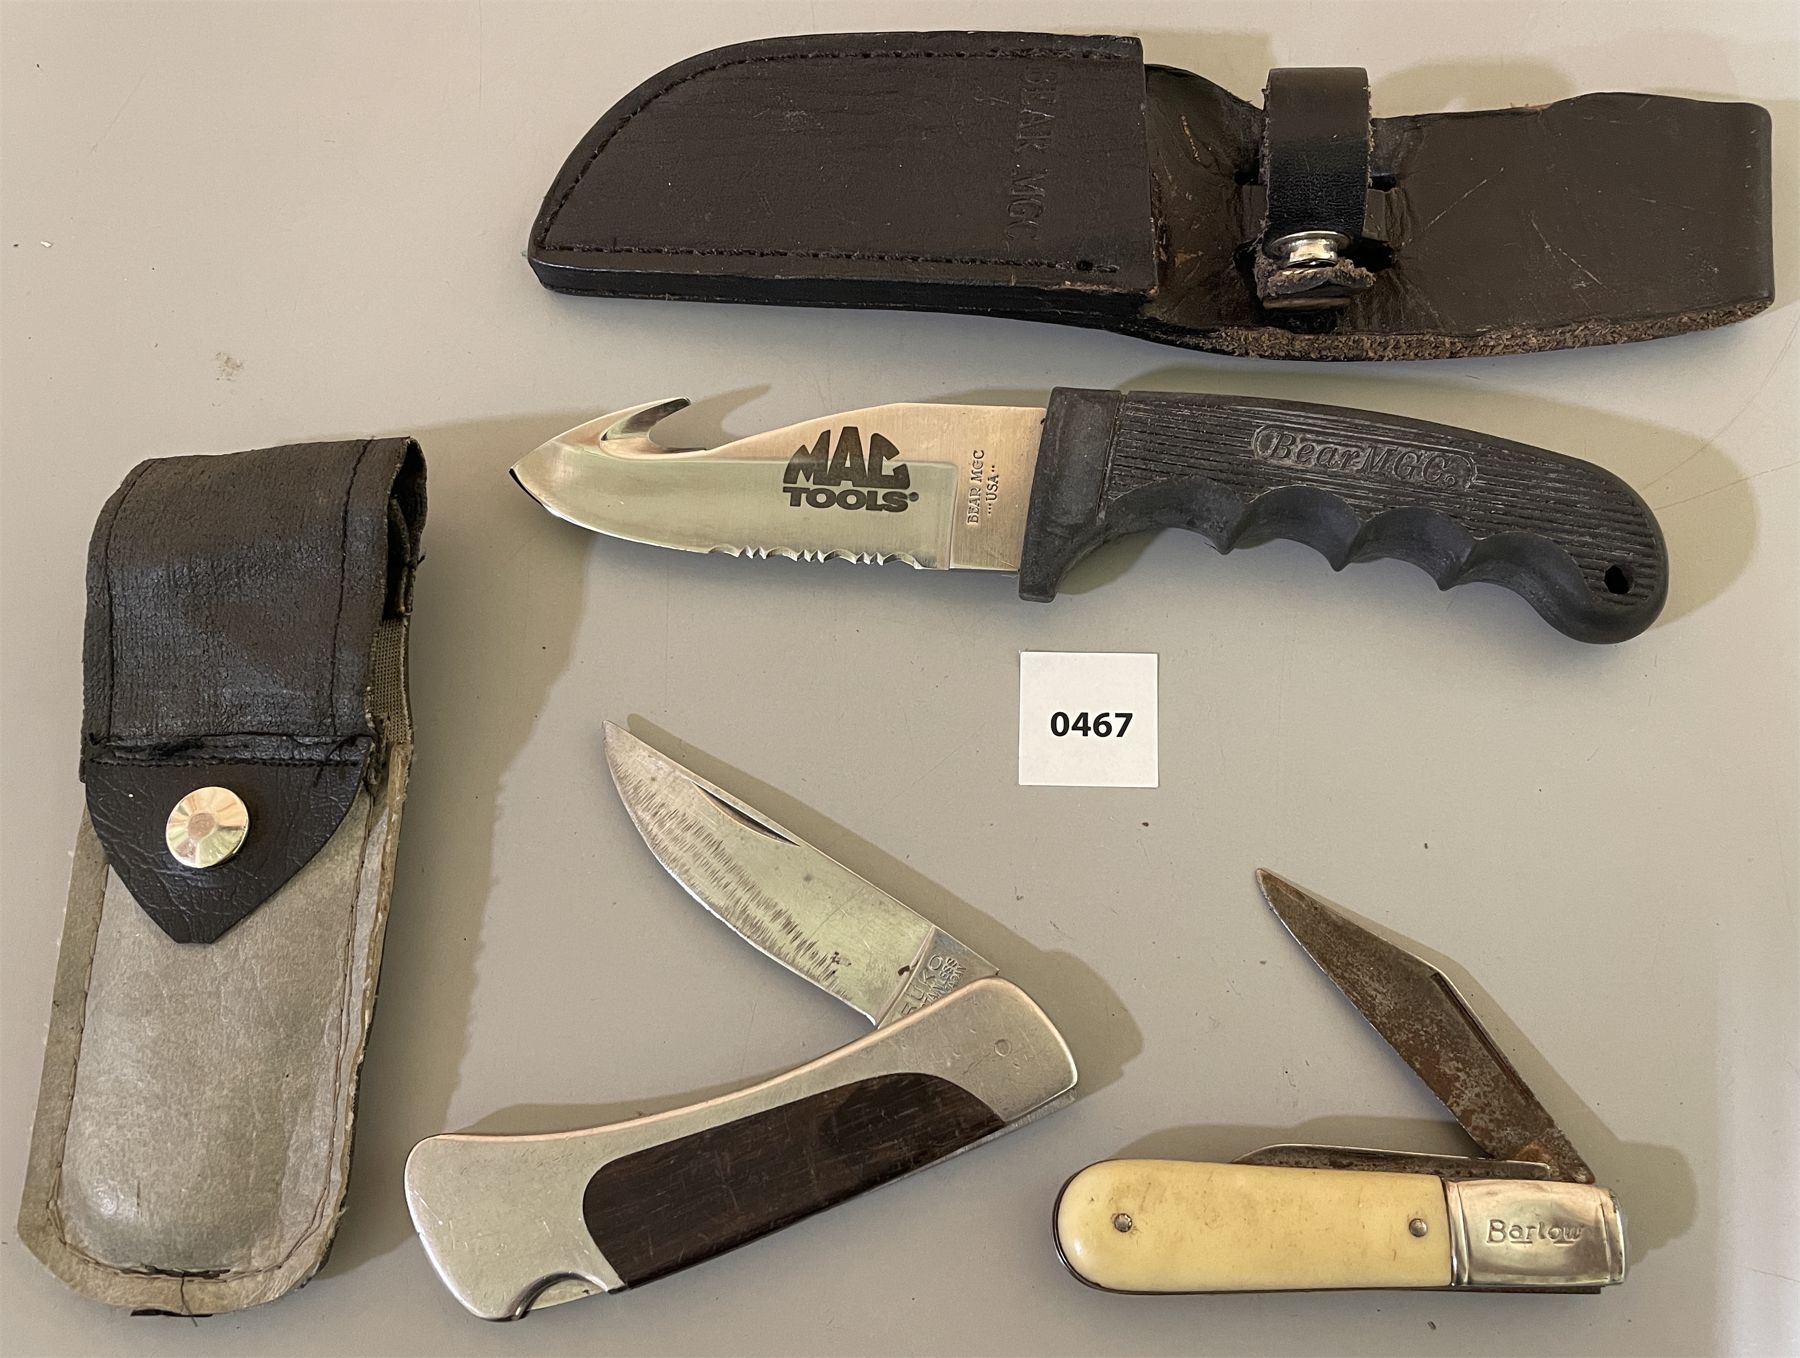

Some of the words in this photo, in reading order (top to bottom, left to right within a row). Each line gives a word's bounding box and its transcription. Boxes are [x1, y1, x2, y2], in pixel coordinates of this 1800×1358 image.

[1015, 64, 1057, 152] BEAR
[1006, 167, 1046, 241] MGC
[783, 426, 911, 490] MAC
[969, 449, 985, 484] MGC
[966, 486, 983, 525] BEAR
[1050, 711, 1134, 738] 0467
[1486, 1218, 1582, 1245] Barlow
